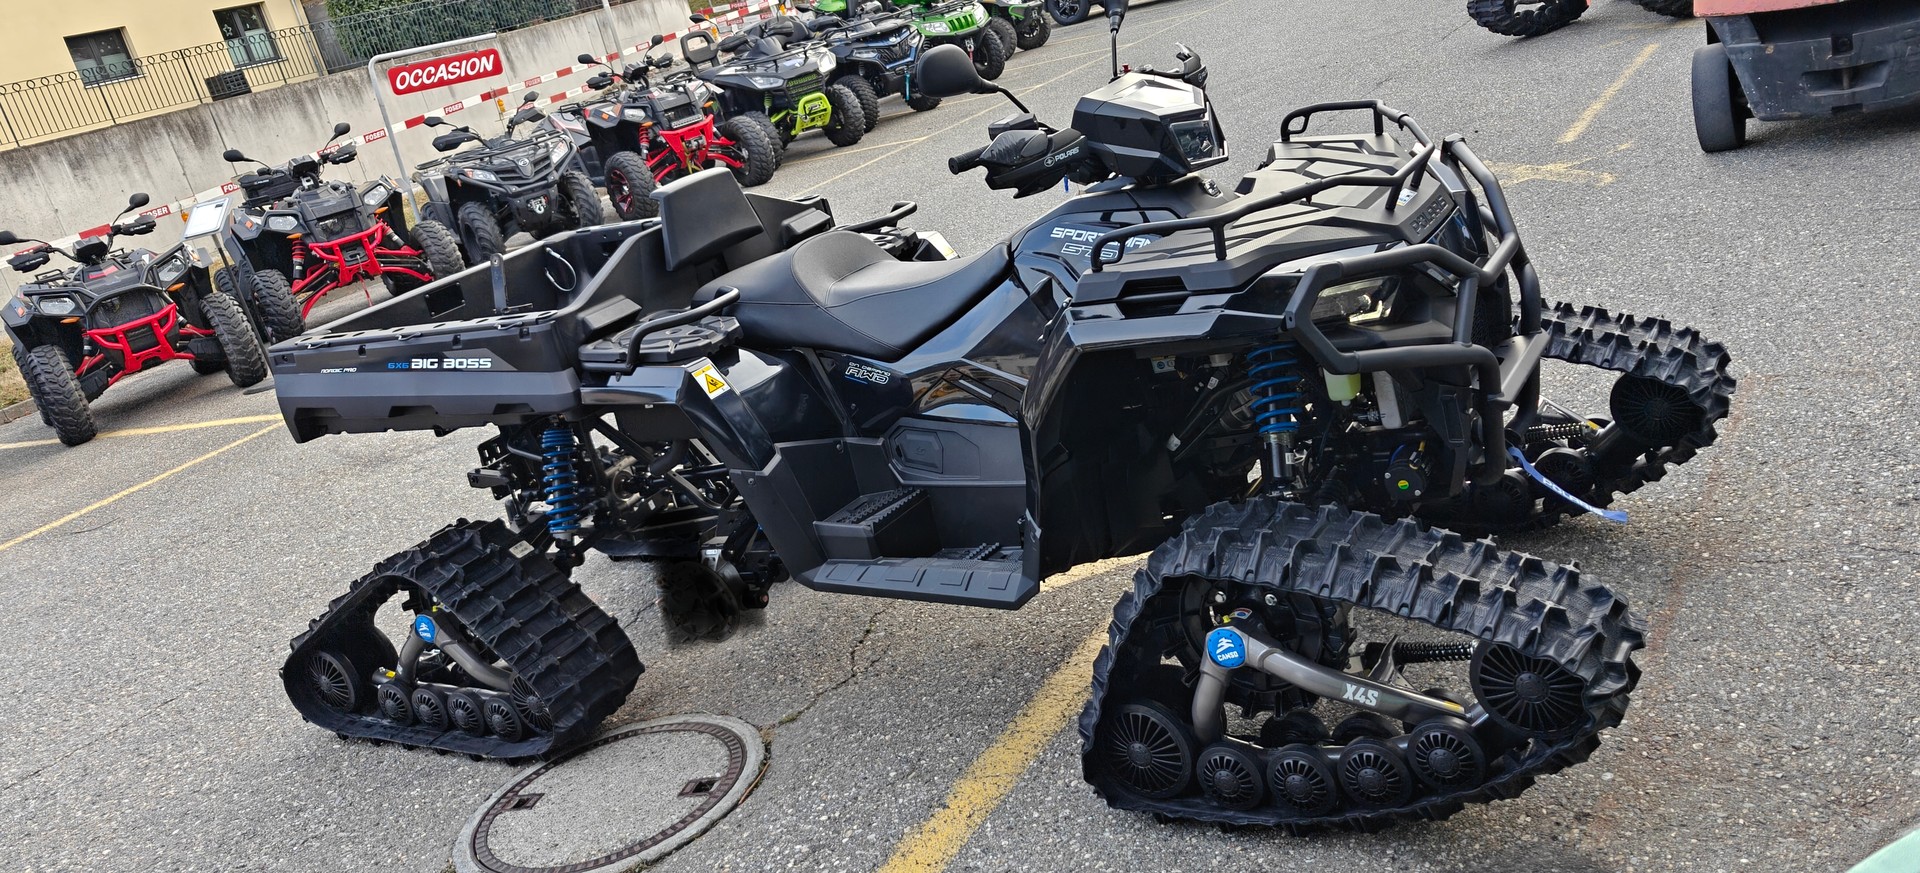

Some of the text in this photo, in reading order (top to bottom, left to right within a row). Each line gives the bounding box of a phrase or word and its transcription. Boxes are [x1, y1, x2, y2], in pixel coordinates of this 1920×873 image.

[395, 54, 494, 90] OCCASION
[445, 103, 463, 114] FOSER
[365, 130, 384, 142] FOSER
[1055, 147, 1080, 162] POLARIS
[411, 358, 438, 369] BIG
[443, 358, 492, 369] BOSS
[845, 365, 889, 385] AWD
[1217, 650, 1240, 662] CAMSO
[1342, 683, 1379, 707] X4S
